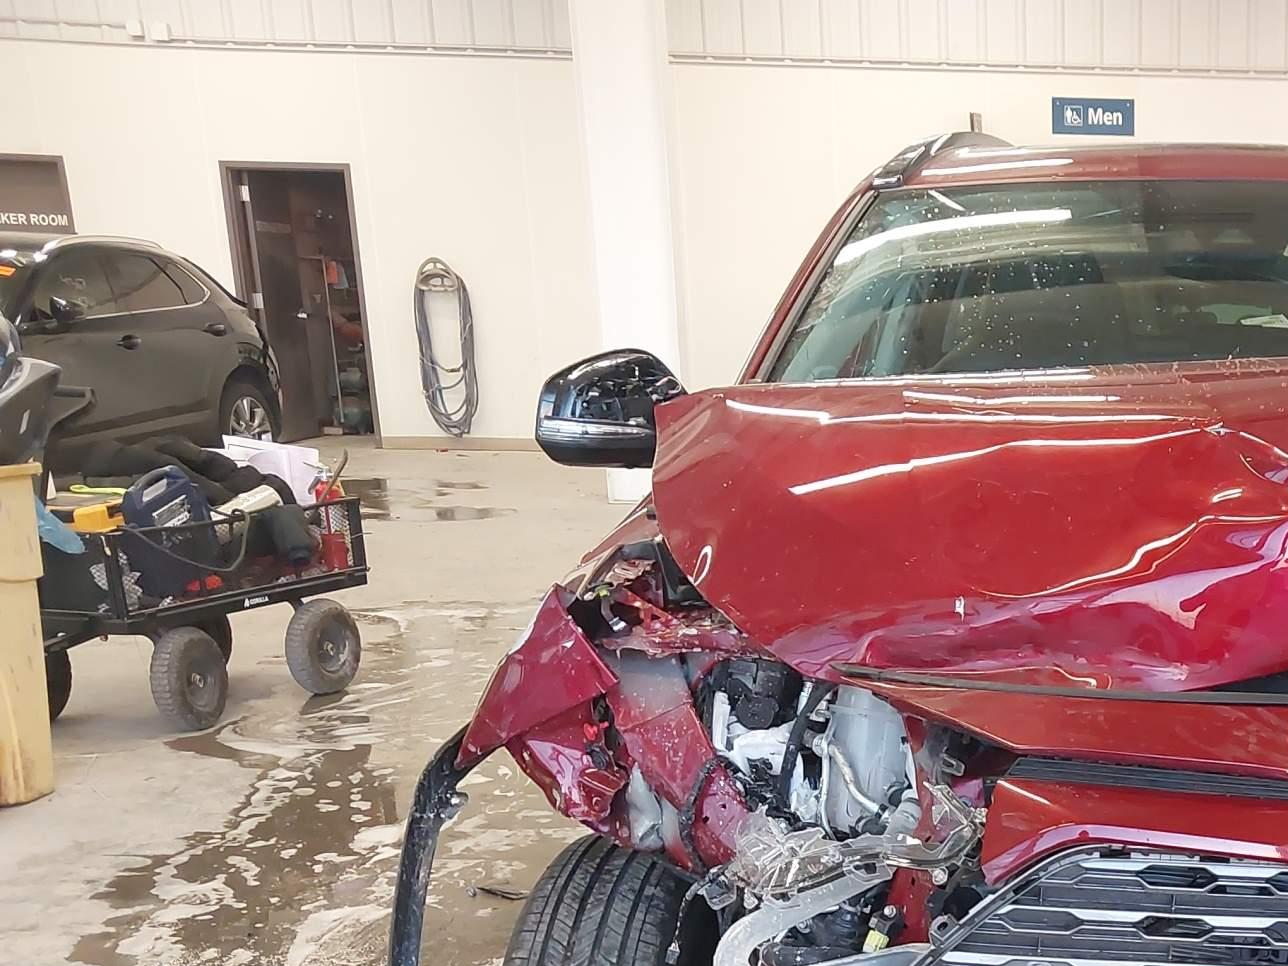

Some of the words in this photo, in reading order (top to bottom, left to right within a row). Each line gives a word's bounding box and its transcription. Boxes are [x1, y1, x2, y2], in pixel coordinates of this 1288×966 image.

[1087, 107, 1123, 125] Men
[0, 212, 28, 226] KER
[29, 213, 69, 227] ROOM
